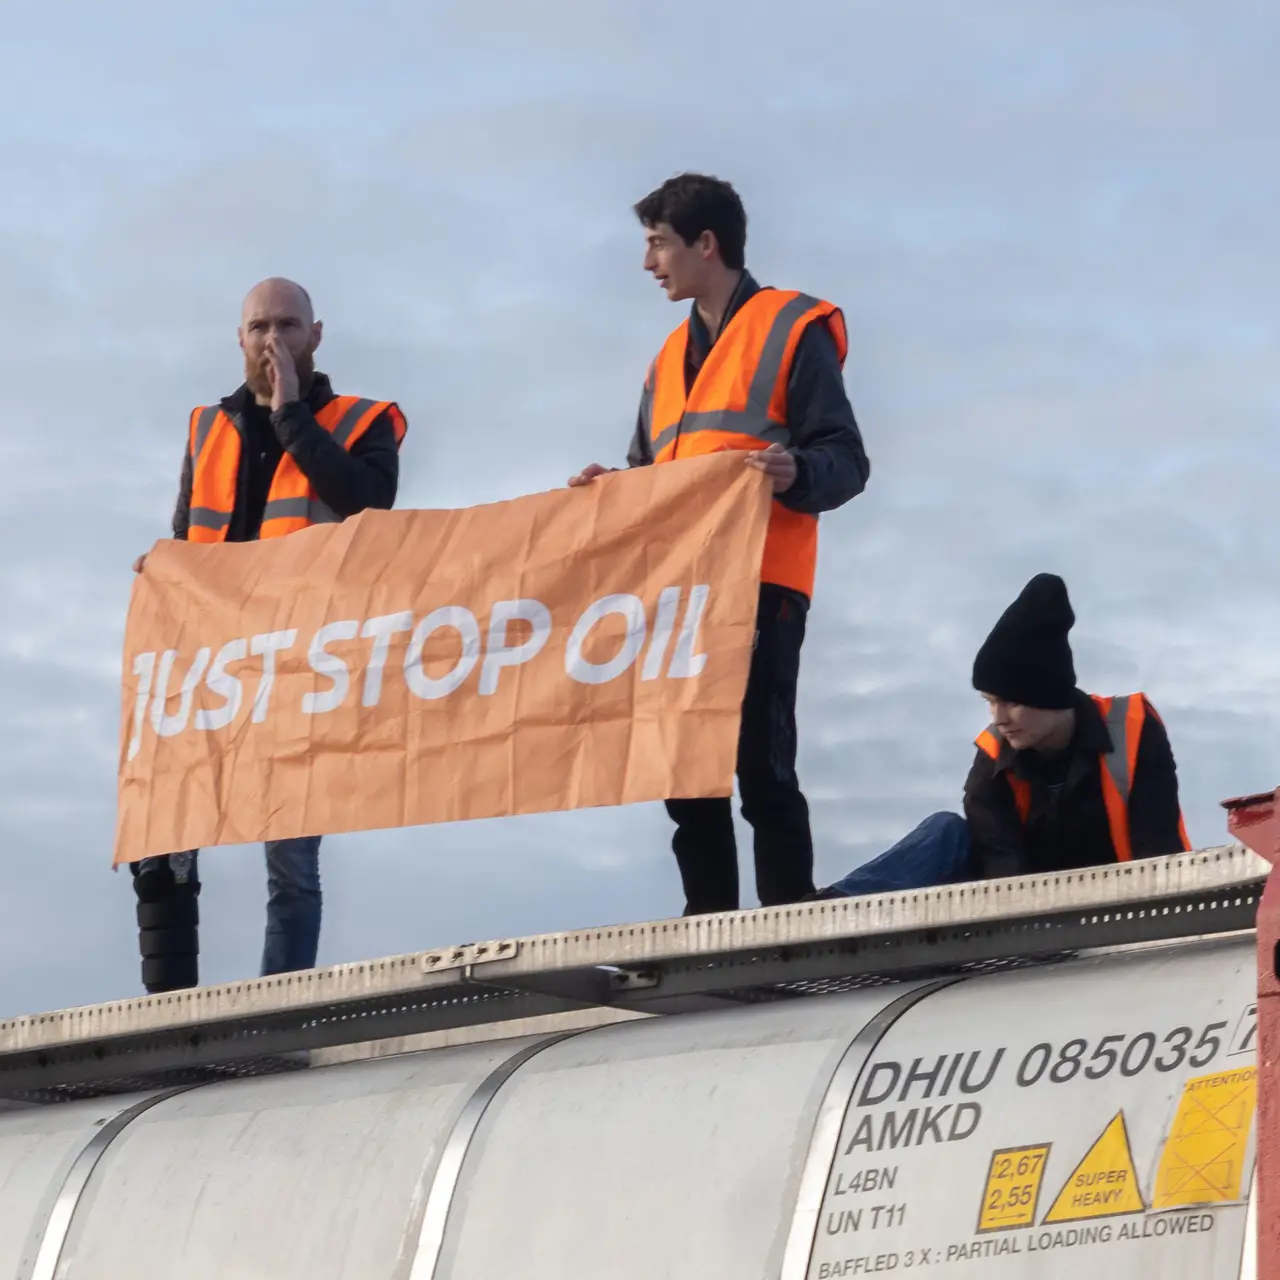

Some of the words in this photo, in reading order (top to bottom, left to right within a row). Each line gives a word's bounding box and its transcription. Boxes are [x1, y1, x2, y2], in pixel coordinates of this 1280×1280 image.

[127, 628, 298, 761] JUST
[301, 598, 553, 714] STOP
[564, 584, 710, 685] OIL
[857, 1047, 1007, 1107] DHIU
[844, 1101, 982, 1155] AMKD
[833, 1165, 898, 1196] L4BN
[1075, 1169, 1128, 1188] SUPER
[988, 1184, 1033, 1212] 2,55
[1072, 1189, 1123, 1208] HEAVY
[826, 1208, 863, 1235] UN
[870, 1203, 907, 1229] T11
[818, 1252, 899, 1280] BAFFLED
[903, 1251, 915, 1268] 3
[918, 1247, 932, 1266] X
[946, 1237, 1022, 1262] PARTIAL
[1027, 1225, 1112, 1251] LOADING
[1117, 1214, 1214, 1240] ALLOWED
